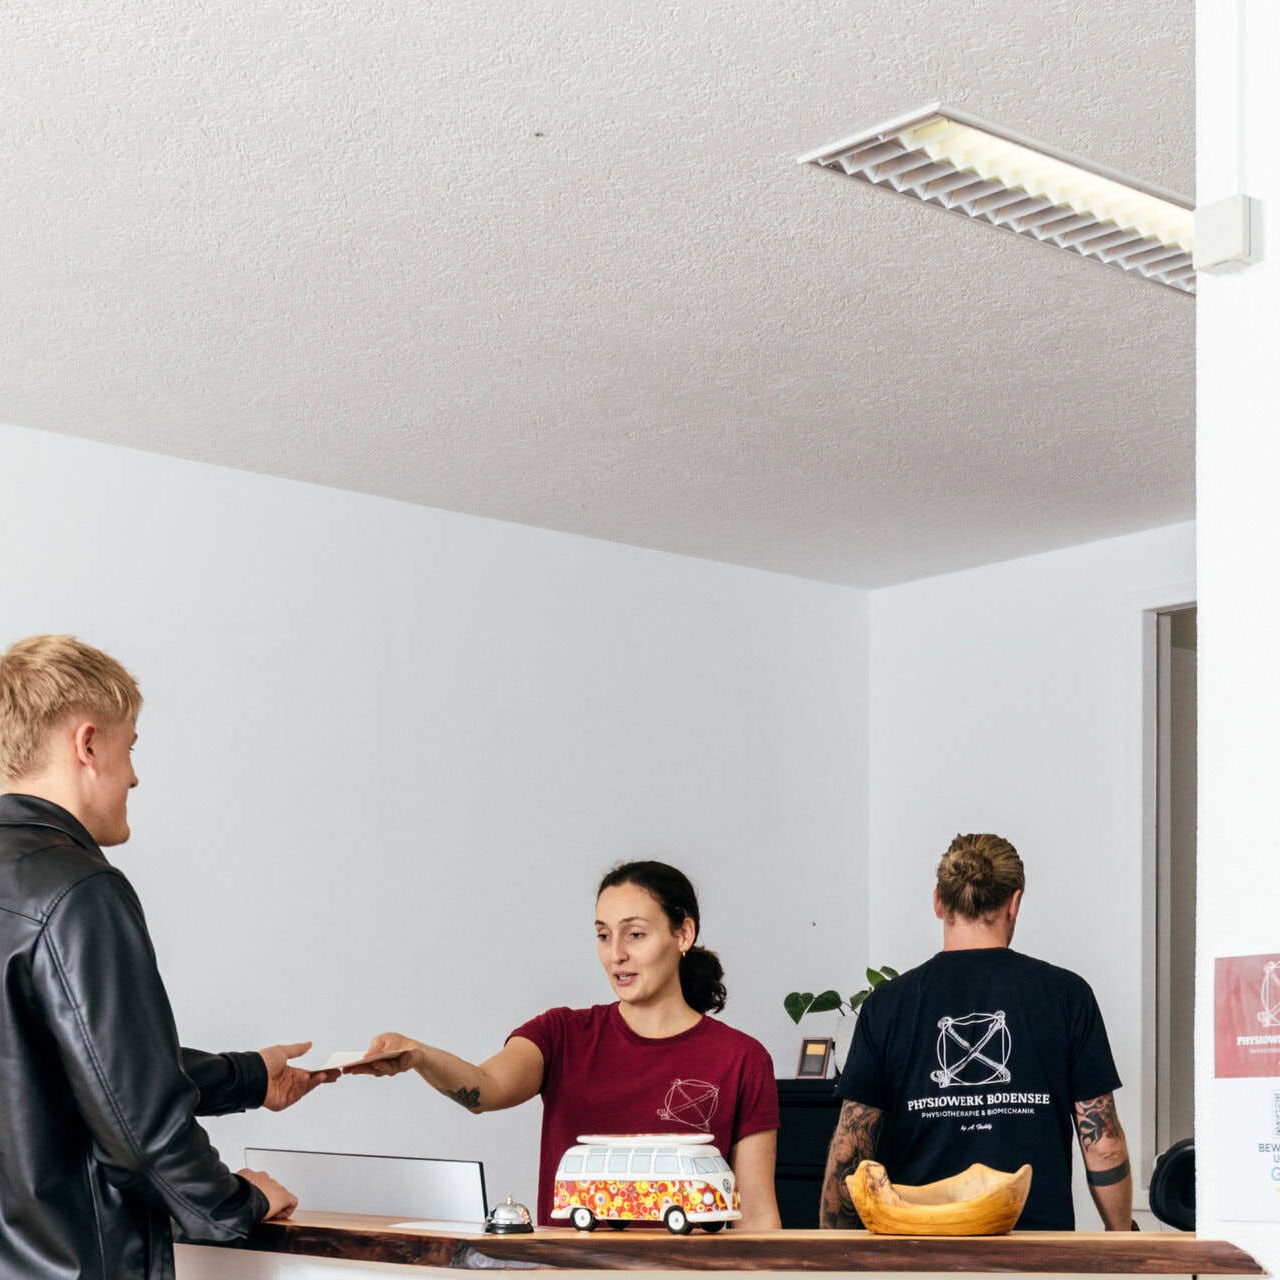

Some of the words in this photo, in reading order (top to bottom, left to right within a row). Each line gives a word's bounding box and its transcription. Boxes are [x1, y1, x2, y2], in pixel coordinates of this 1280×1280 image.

[907, 1096, 984, 1111] PHYSIOWERK
[986, 1093, 1050, 1105] BODENSEE
[921, 1110, 980, 1119] PHYSIOTHERAPIE
[986, 1107, 1035, 1116] BIOMECHANIK
